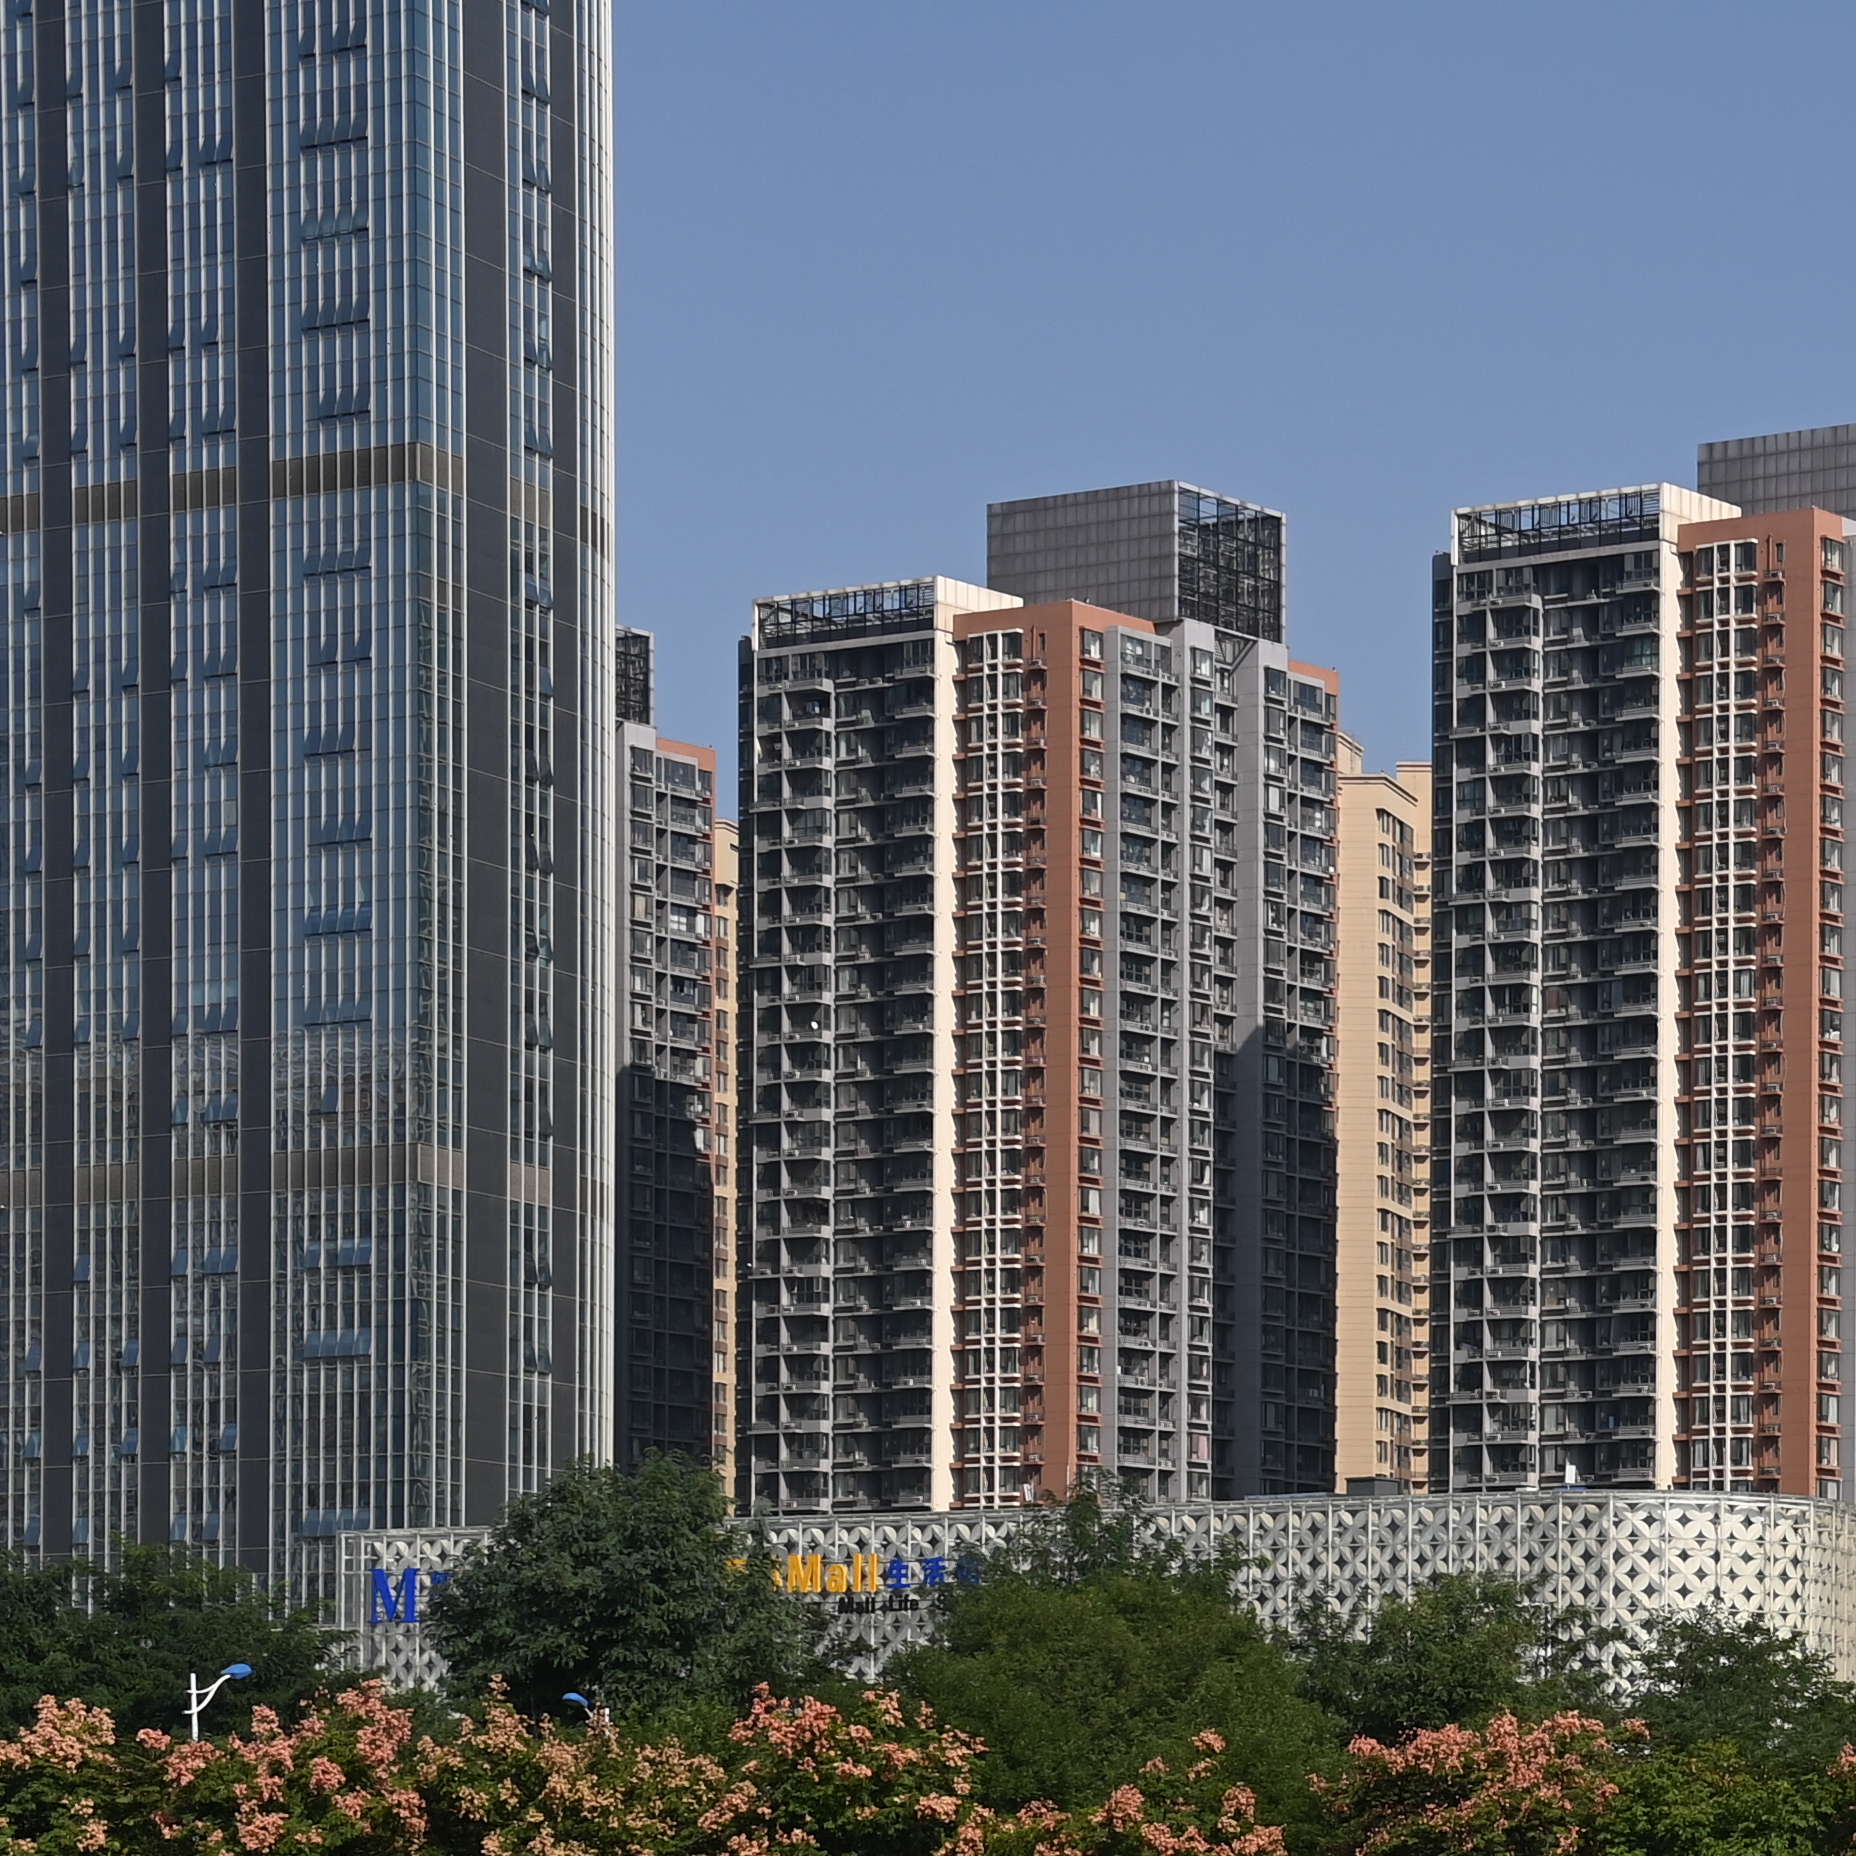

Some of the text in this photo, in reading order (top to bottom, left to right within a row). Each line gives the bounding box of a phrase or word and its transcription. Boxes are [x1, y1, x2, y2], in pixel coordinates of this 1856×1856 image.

[787, 1553, 878, 1593] Mall
[367, 1568, 420, 1623] M
[888, 1593, 919, 1611] Life
